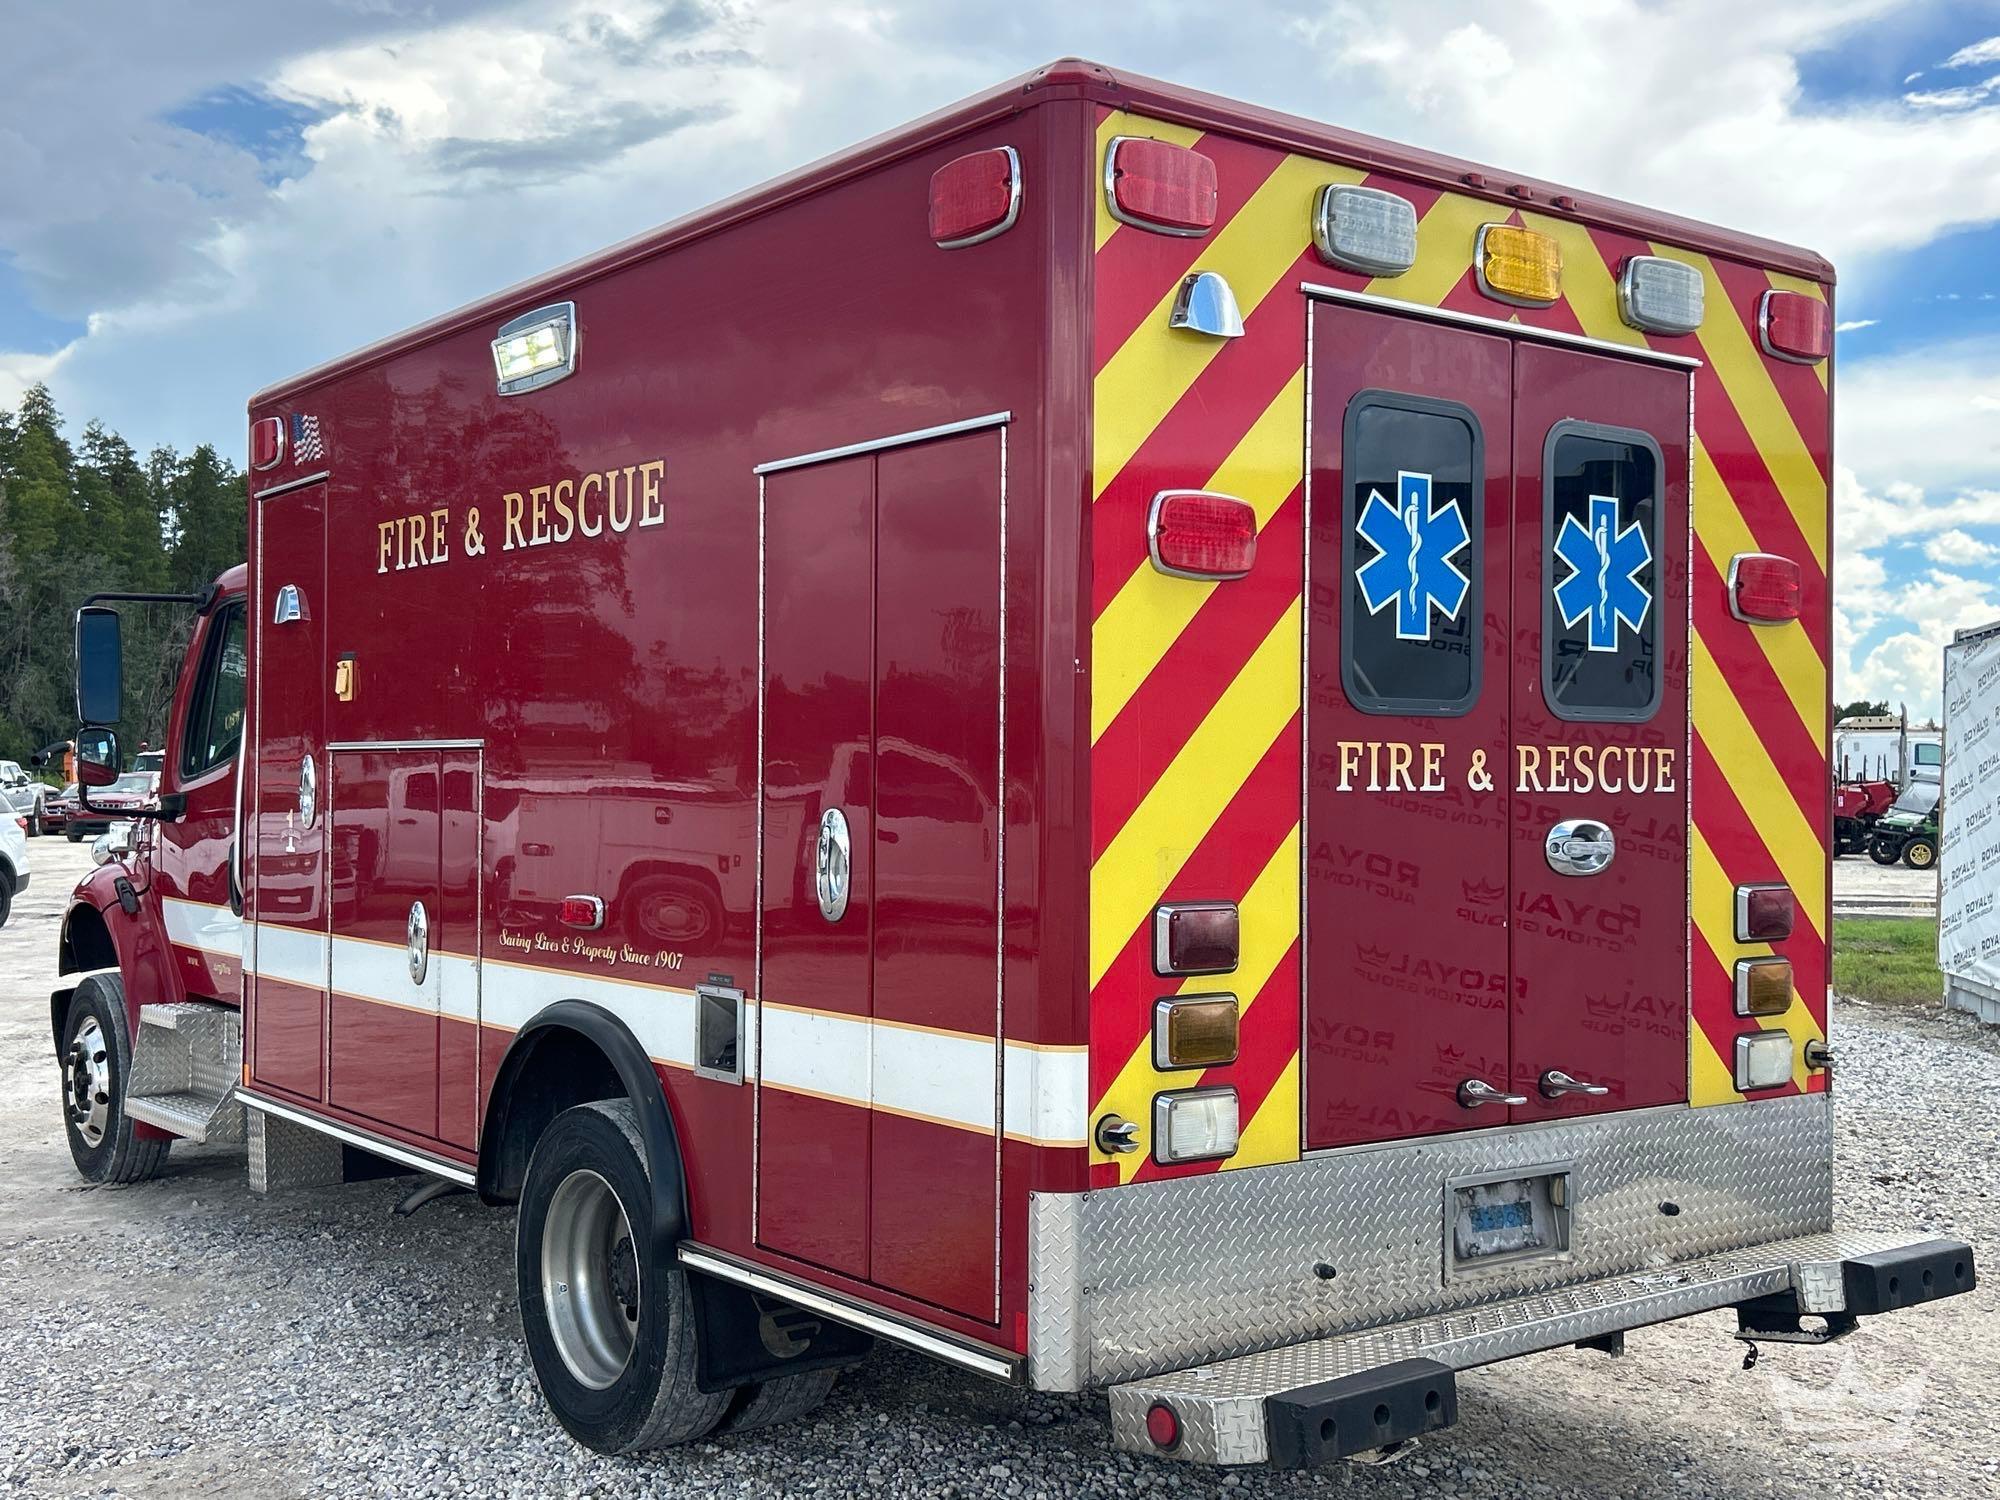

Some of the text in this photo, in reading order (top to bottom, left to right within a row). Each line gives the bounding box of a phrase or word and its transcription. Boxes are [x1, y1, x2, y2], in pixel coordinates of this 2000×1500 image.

[377, 460, 664, 573] FIRE & RESCUE
[1964, 720, 1984, 744] ROYAL
[1336, 741, 1445, 792] FIRE
[1467, 749, 1494, 792] &
[1516, 745, 1675, 794] RESCUE
[1979, 752, 1999, 776] ROYAL
[1966, 808, 1985, 828] ROYAL
[1966, 896, 1987, 914] ROYAL
[500, 928, 683, 970] Saving Lives & Property Since 1907
